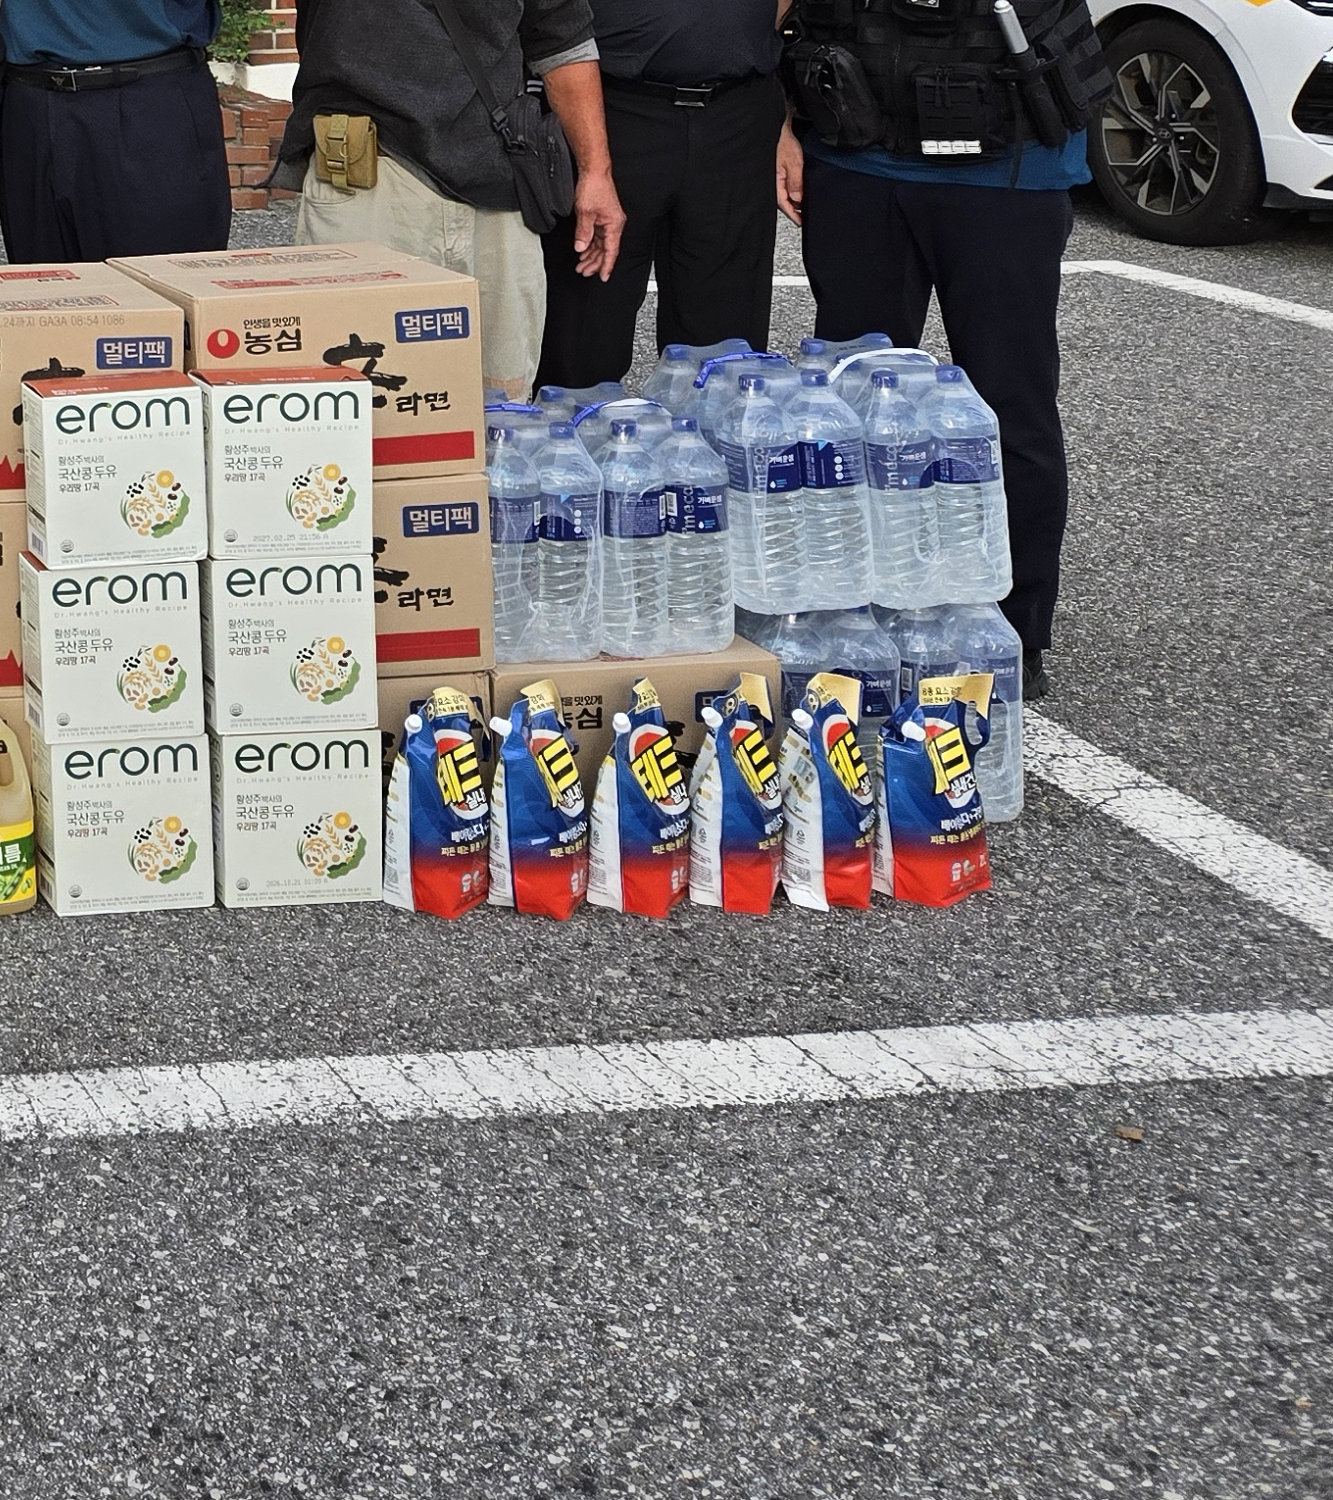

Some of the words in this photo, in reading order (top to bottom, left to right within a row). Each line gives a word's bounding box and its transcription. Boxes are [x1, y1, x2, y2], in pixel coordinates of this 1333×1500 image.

[39, 315, 68, 328] GA3A
[71, 315, 100, 327] 08:54
[102, 314, 125, 326] 1086
[401, 311, 464, 337] 멀티팩
[244, 329, 303, 355] 농심
[103, 340, 166, 365] 멀티팩
[224, 391, 359, 424] erom
[395, 390, 451, 416] 라면
[56, 396, 190, 434] erom
[117, 432, 154, 443] Healthy
[158, 429, 191, 439] Recipe
[285, 424, 324, 434] Healthy
[329, 423, 360, 432] Recipe
[225, 445, 249, 456] 황성주
[58, 455, 83, 465] 황성주
[224, 457, 258, 470] 국산콩
[261, 456, 283, 469] 두유
[58, 467, 93, 480] 국산콩
[95, 465, 117, 478] 두유
[250, 473, 265, 482] 17곡
[85, 482, 100, 491] 17곡
[410, 507, 473, 533] 멀티팩
[226, 563, 362, 598] erom
[52, 571, 188, 608] erom
[397, 587, 455, 611] 라면
[114, 607, 151, 617] Healthy
[155, 605, 188, 613] Recipe
[54, 628, 78, 639] 황성주
[228, 631, 262, 644] 국산콩
[264, 629, 287, 642] 두유
[54, 640, 89, 653] 국산콩
[91, 639, 114, 652] 두유
[80, 655, 96, 665] 17곡
[65, 743, 198, 780] erom
[235, 739, 369, 773] erom
